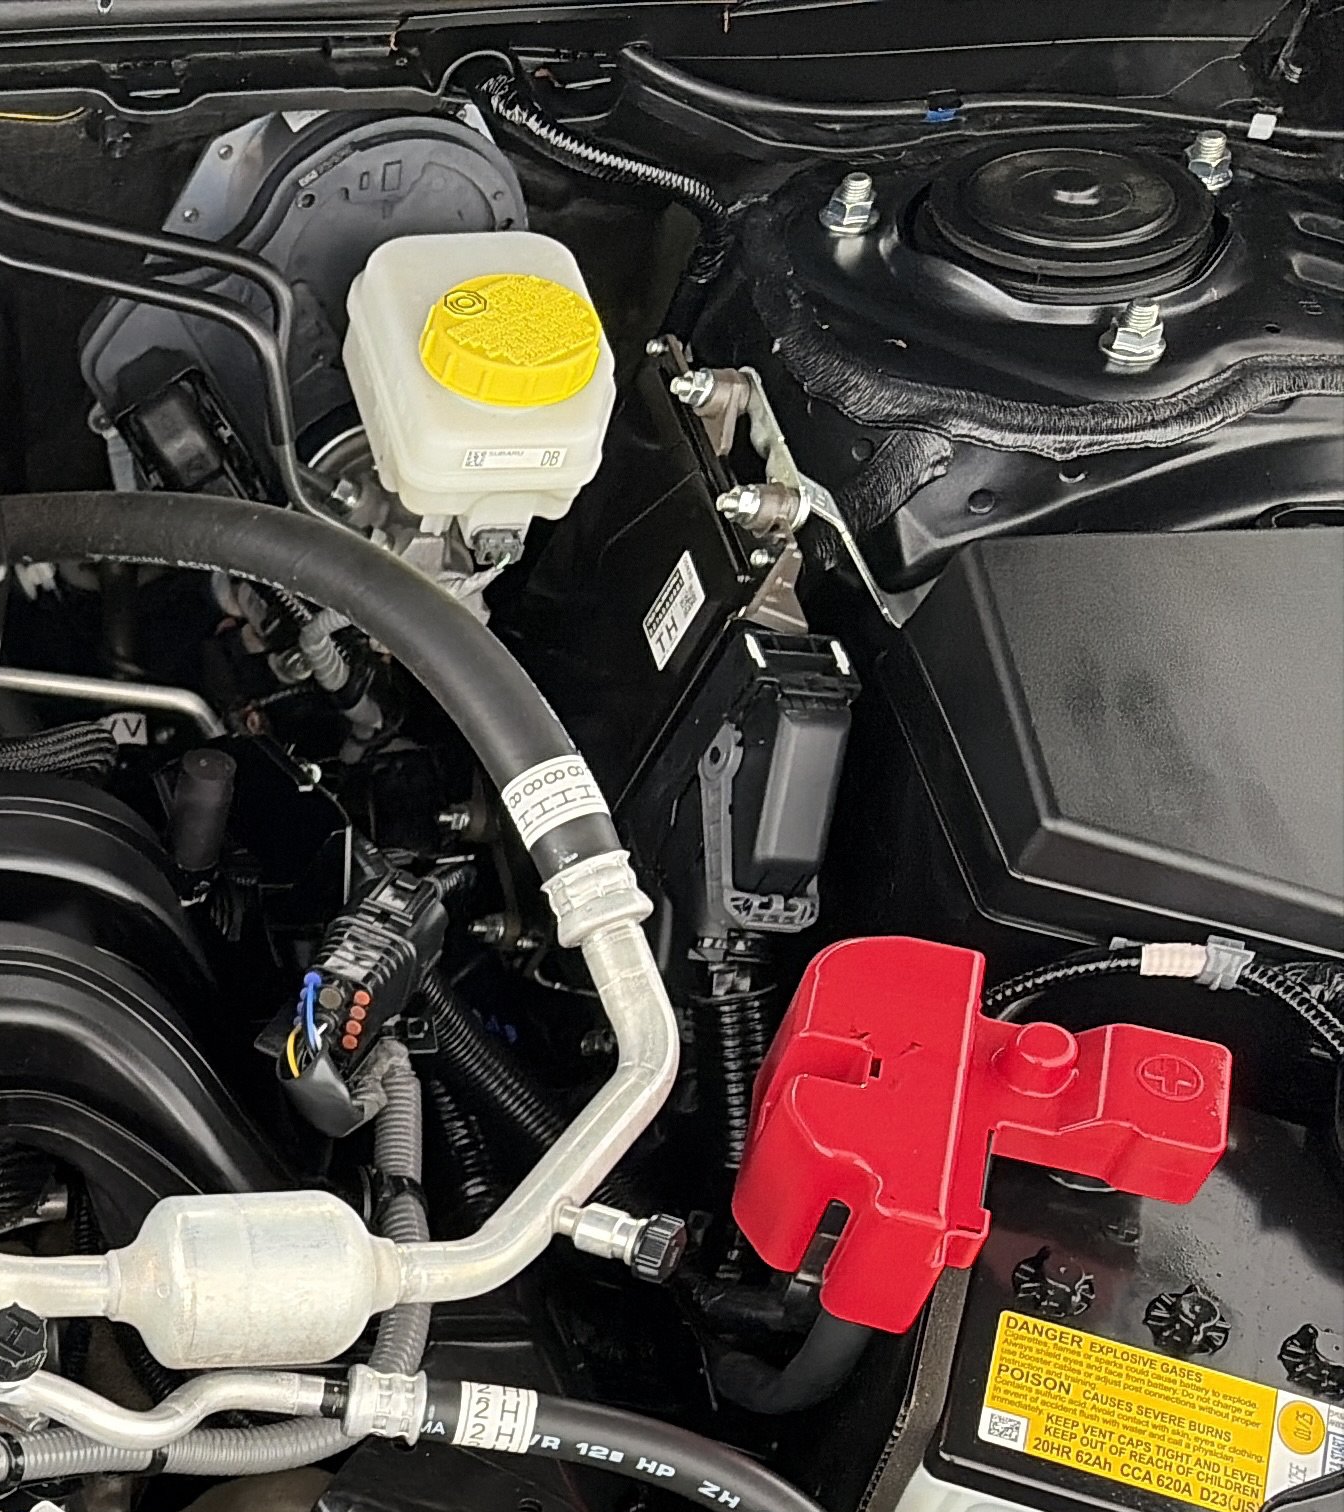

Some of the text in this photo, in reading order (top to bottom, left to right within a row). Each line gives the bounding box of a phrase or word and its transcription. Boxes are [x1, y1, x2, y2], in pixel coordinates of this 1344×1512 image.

[541, 450, 560, 466] DB
[655, 616, 678, 653] TH
[1005, 1316, 1202, 1382] DANGER EXPLOSIVE GASES
[997, 1362, 1232, 1442] POISON CAUSES SEVERE BURNS
[1032, 1436, 1072, 1460] 20HR
[1074, 1449, 1113, 1472] 62Ah
[1119, 1462, 1153, 1484] CCA
[1155, 1473, 1193, 1496] 620A
[1043, 1424, 1259, 1498] KEEP OUT OF REACH OF CHILDREN
[1045, 1412, 1262, 1486] KEEP VENT CAPS TIGHT AND LEVEL
[635, 1457, 676, 1478] HP
[697, 1480, 741, 1509] ZH
